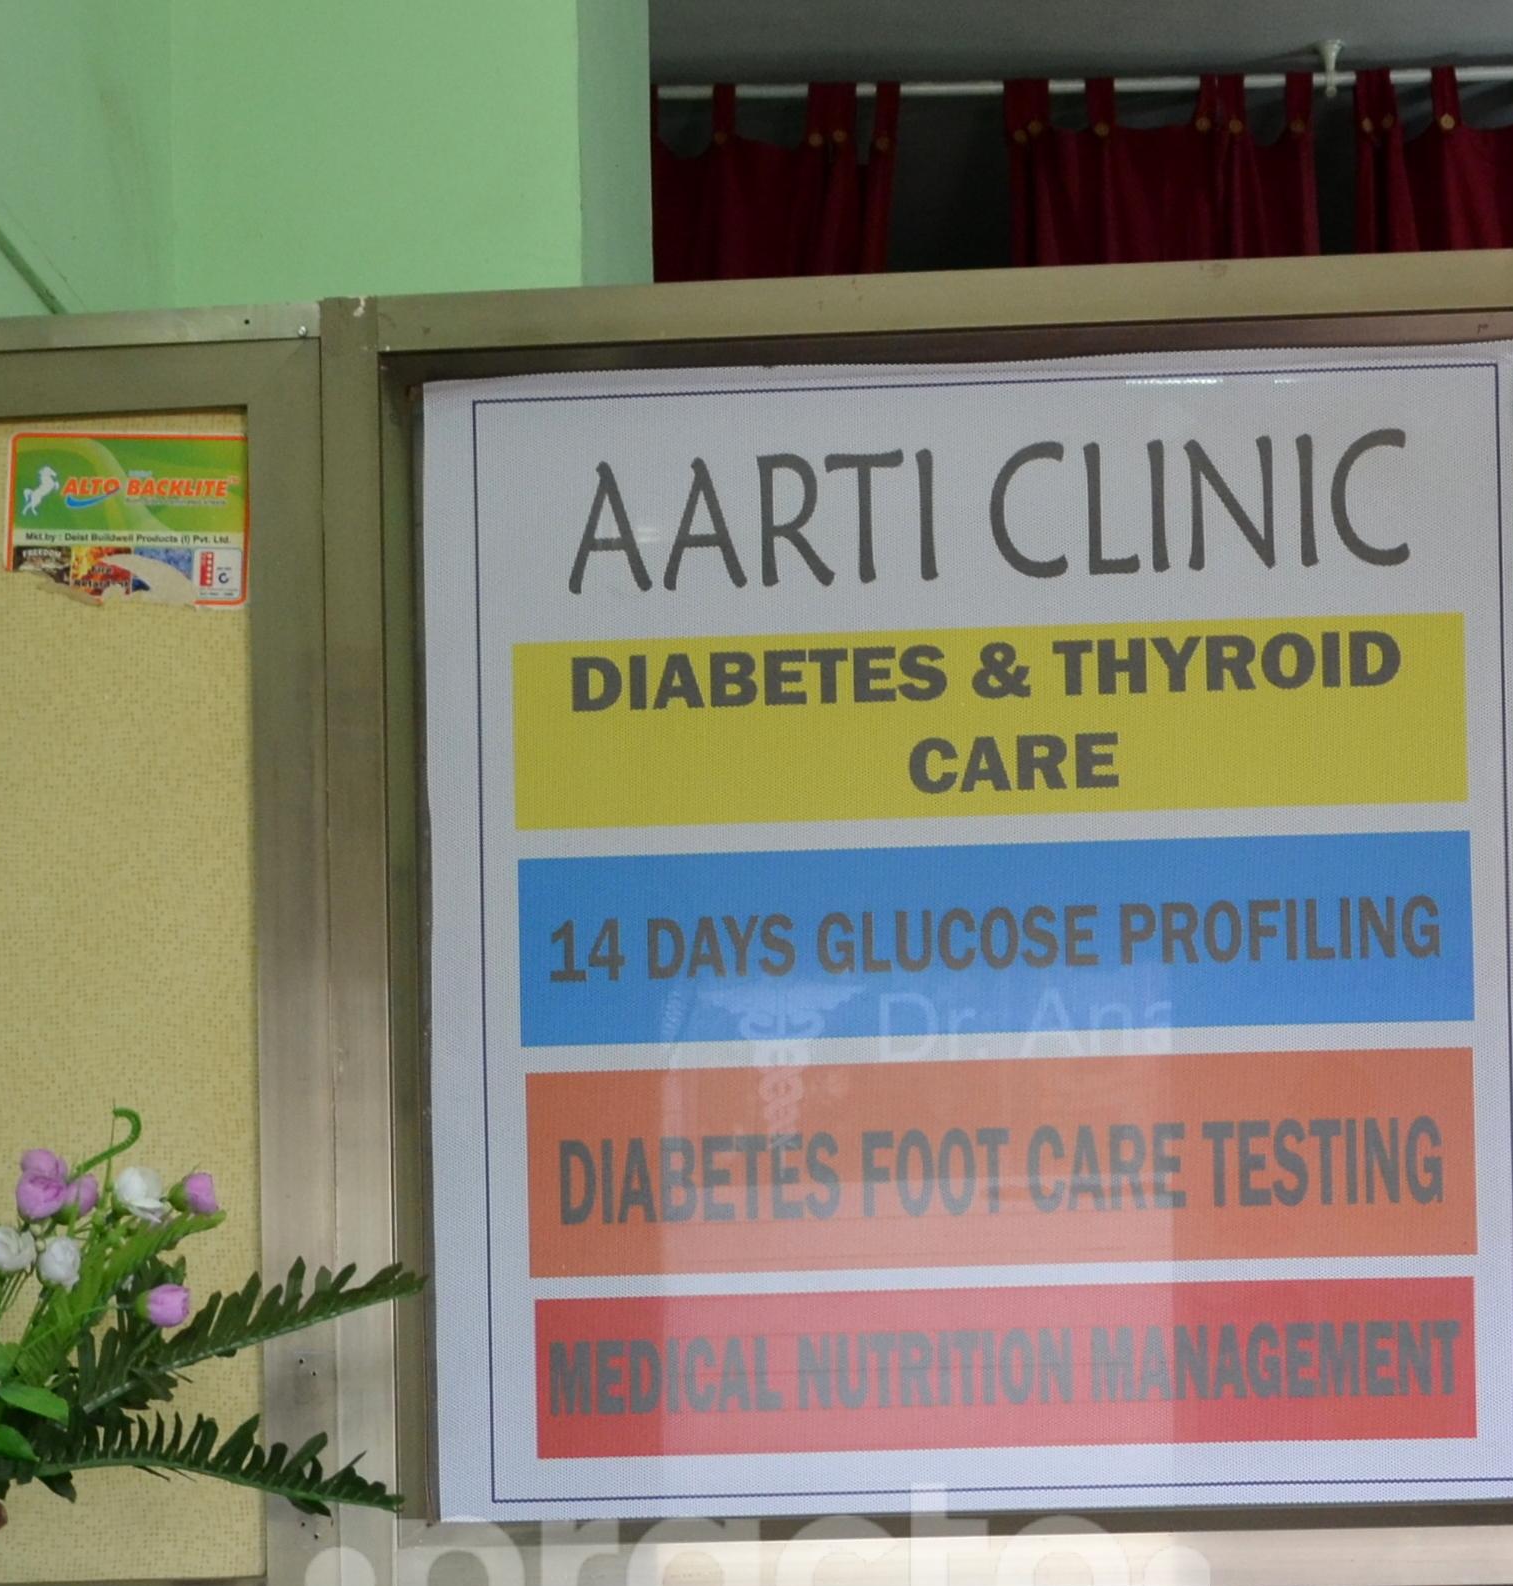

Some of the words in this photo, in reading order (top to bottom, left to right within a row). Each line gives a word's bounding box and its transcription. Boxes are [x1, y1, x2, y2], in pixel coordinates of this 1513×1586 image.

[62, 478, 121, 497] ALTO
[126, 478, 229, 498] BACKLITE
[568, 448, 940, 594] AARTI
[989, 428, 1411, 580] CLINIC
[136, 534, 179, 544] Products
[193, 535, 211, 545] Pvt.
[213, 535, 232, 544] Ltd.
[73, 578, 131, 590] Retardnt
[570, 646, 948, 712] DIABETES
[971, 642, 1031, 698] &
[1050, 630, 1401, 695] THYROID
[908, 733, 1120, 793] CARE
[549, 918, 624, 982] 14
[648, 914, 795, 980] DAYS
[817, 904, 1098, 975] GLUCOSE
[1120, 895, 1440, 965] PROFILING
[559, 1130, 839, 1225] DIABETES
[861, 1126, 1008, 1217] FOOT
[1027, 1122, 1185, 1212] CARE
[1202, 1115, 1444, 1209] TESTING
[549, 1335, 783, 1417] MEDICAL
[796, 1328, 1072, 1410] NUTRITION
[1091, 1321, 1460, 1402] MANAGEMENT
